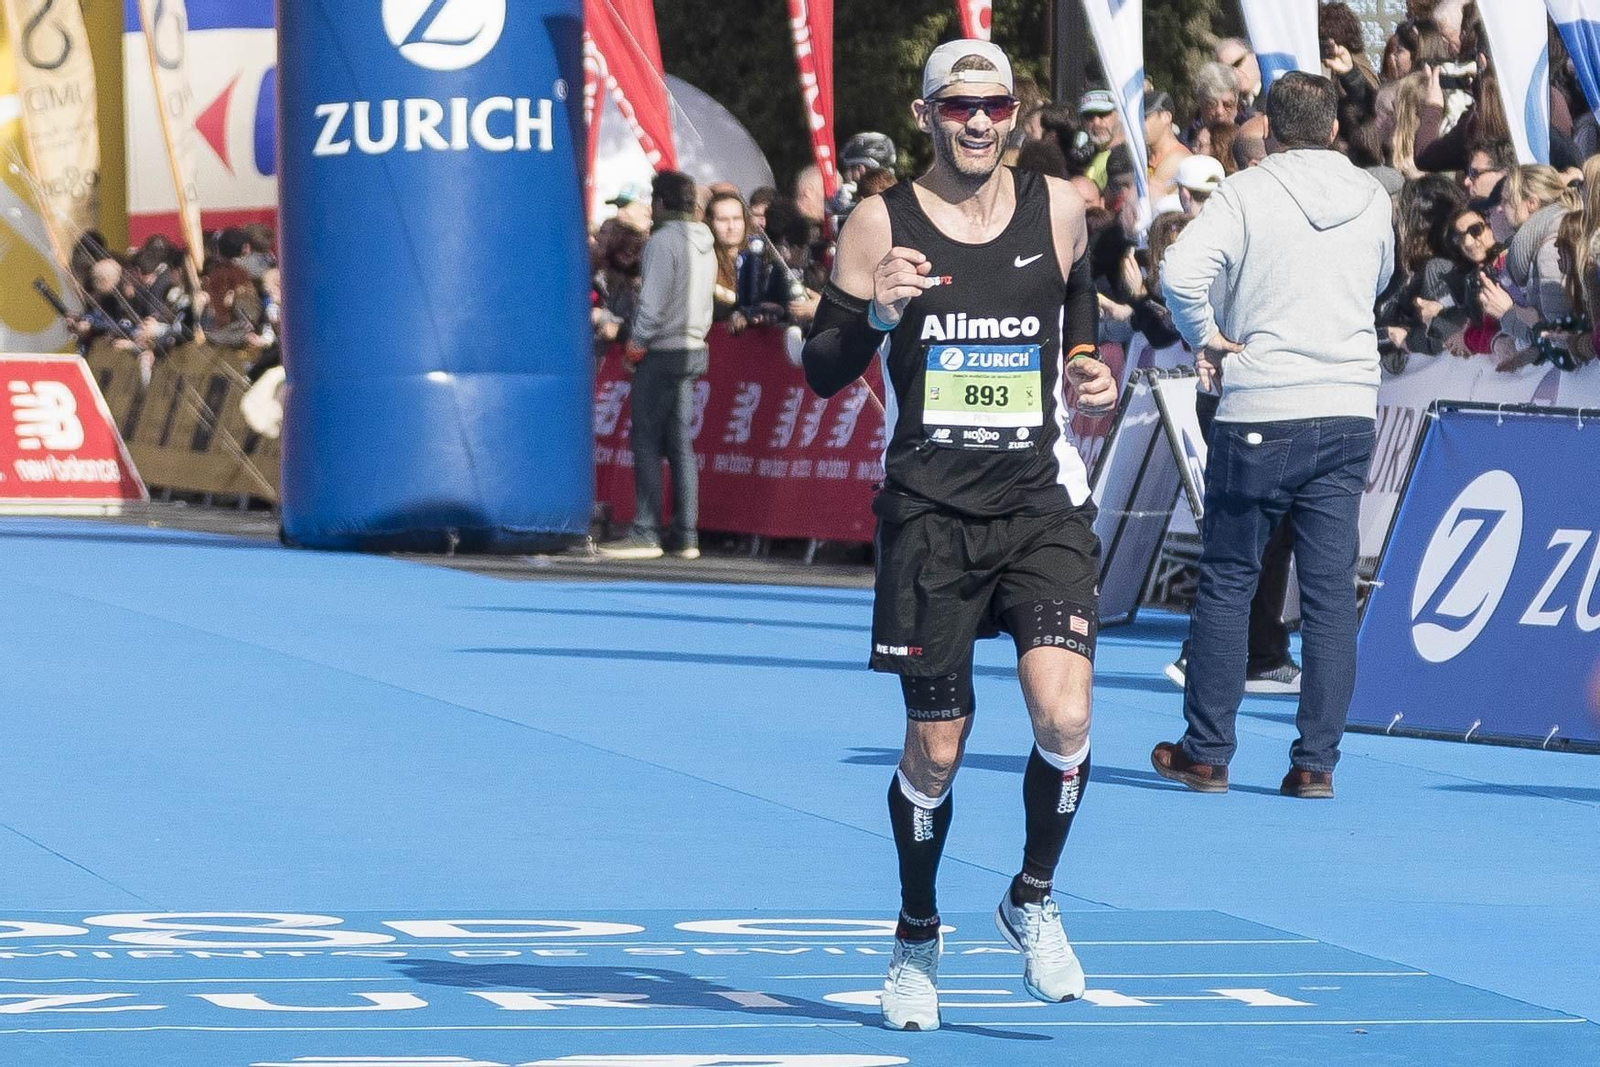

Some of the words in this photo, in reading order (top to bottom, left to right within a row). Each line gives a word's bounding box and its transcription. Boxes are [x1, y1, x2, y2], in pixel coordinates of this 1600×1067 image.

[313, 97, 553, 156] ZURICH
[921, 312, 1040, 340] Alimco
[966, 352, 1030, 367] ZURICH
[964, 384, 1009, 407] 893
[913, 806, 924, 841] COMPRE
[449, 949, 589, 957] DE
